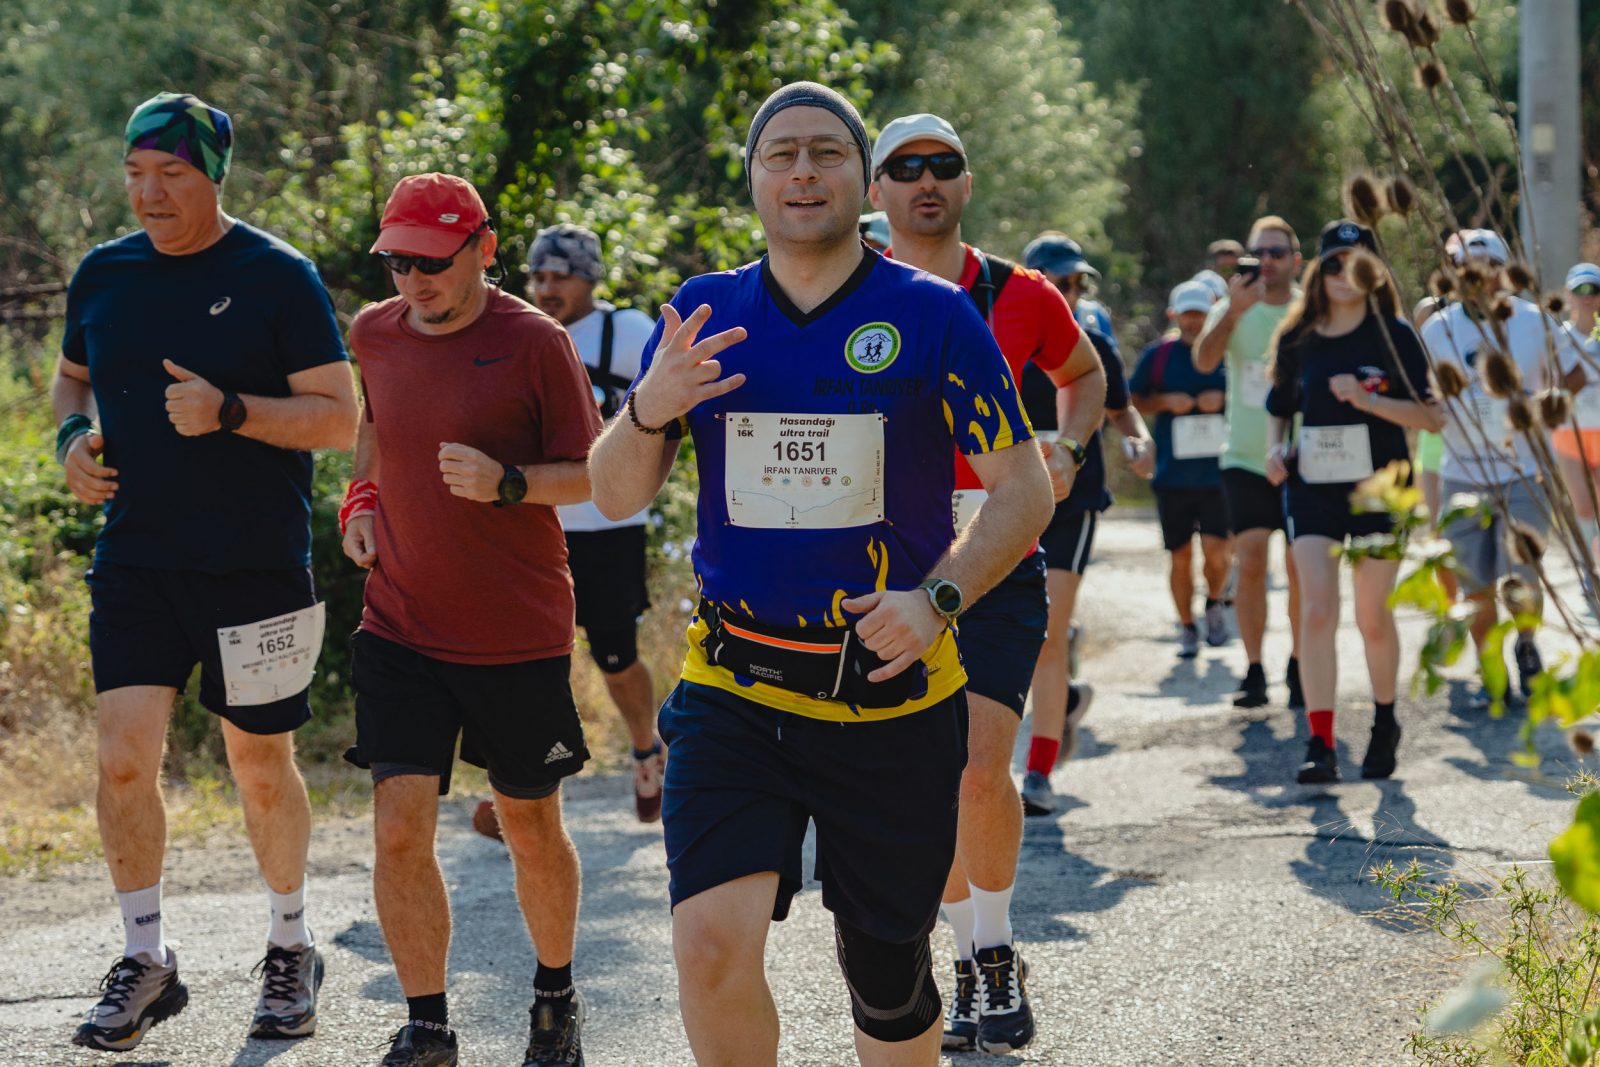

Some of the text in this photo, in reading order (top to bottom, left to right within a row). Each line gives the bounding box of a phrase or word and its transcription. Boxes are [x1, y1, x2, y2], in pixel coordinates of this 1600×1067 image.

[780, 417, 835, 427] Hasandağı
[780, 429, 829, 437] ultra trail
[773, 441, 825, 461] 1651
[764, 465, 790, 474] İRFAN
[257, 634, 294, 656] 1652
[750, 664, 780, 675] NORTH
[750, 670, 783, 681] PACIFIC
[544, 751, 574, 764] adidas
